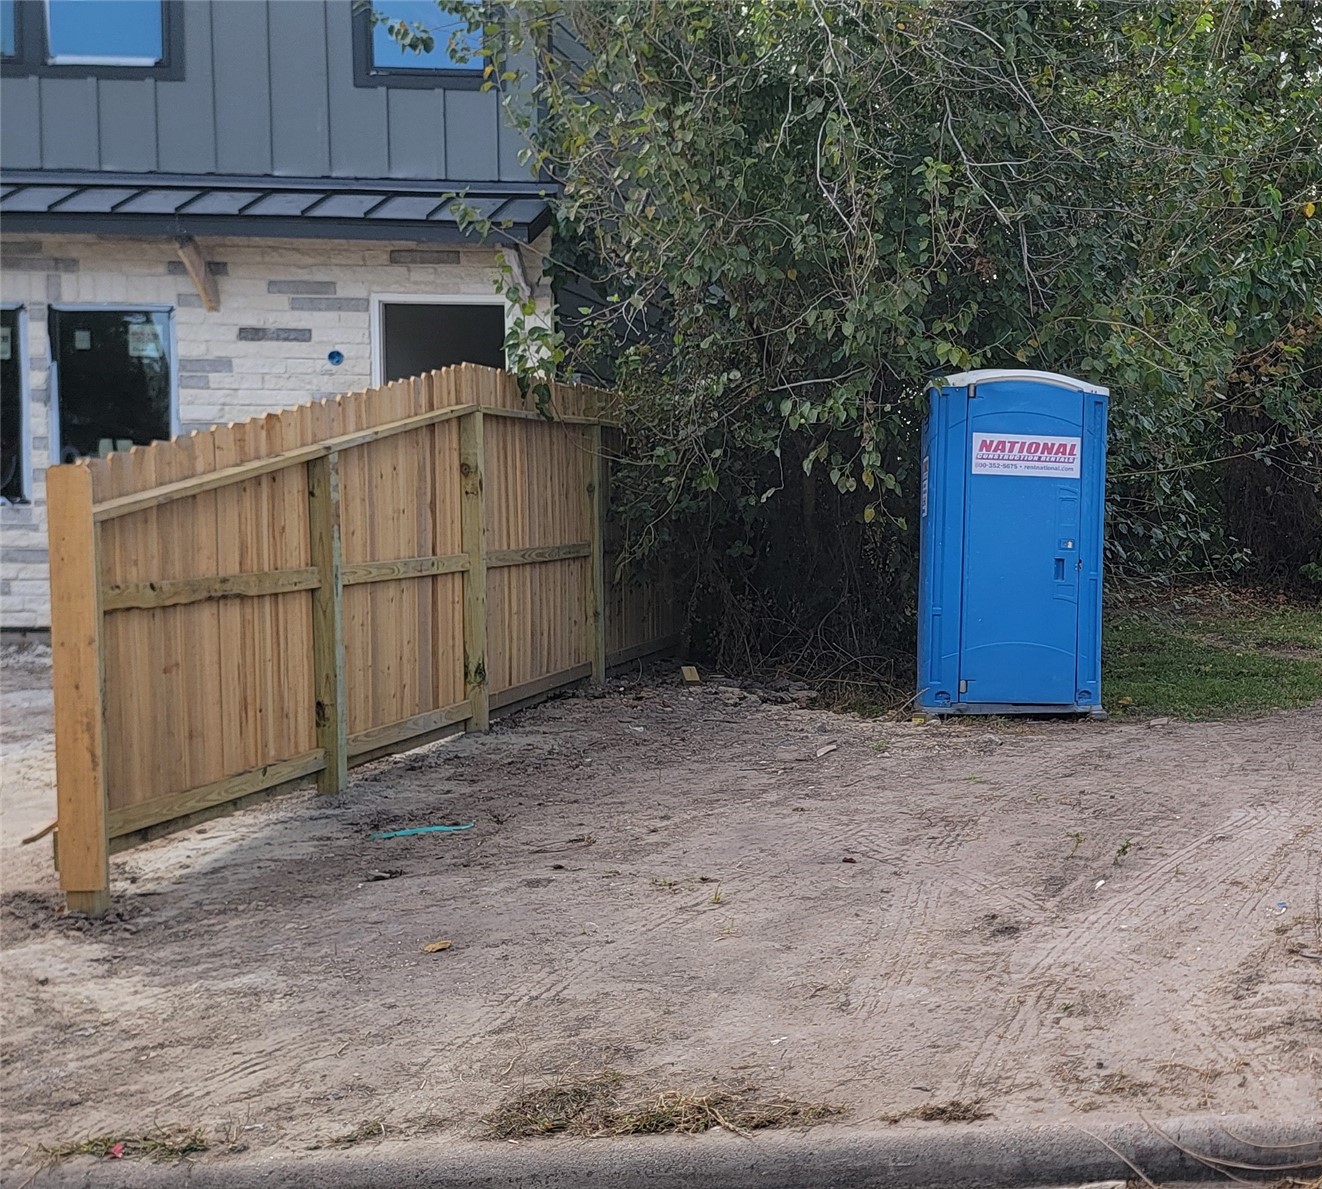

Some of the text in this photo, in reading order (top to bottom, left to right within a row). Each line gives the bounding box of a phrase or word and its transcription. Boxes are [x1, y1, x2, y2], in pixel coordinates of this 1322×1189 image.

[979, 440, 1077, 456] NATIONAL
[977, 453, 1074, 463] CONSTRUCTION RENTALS
